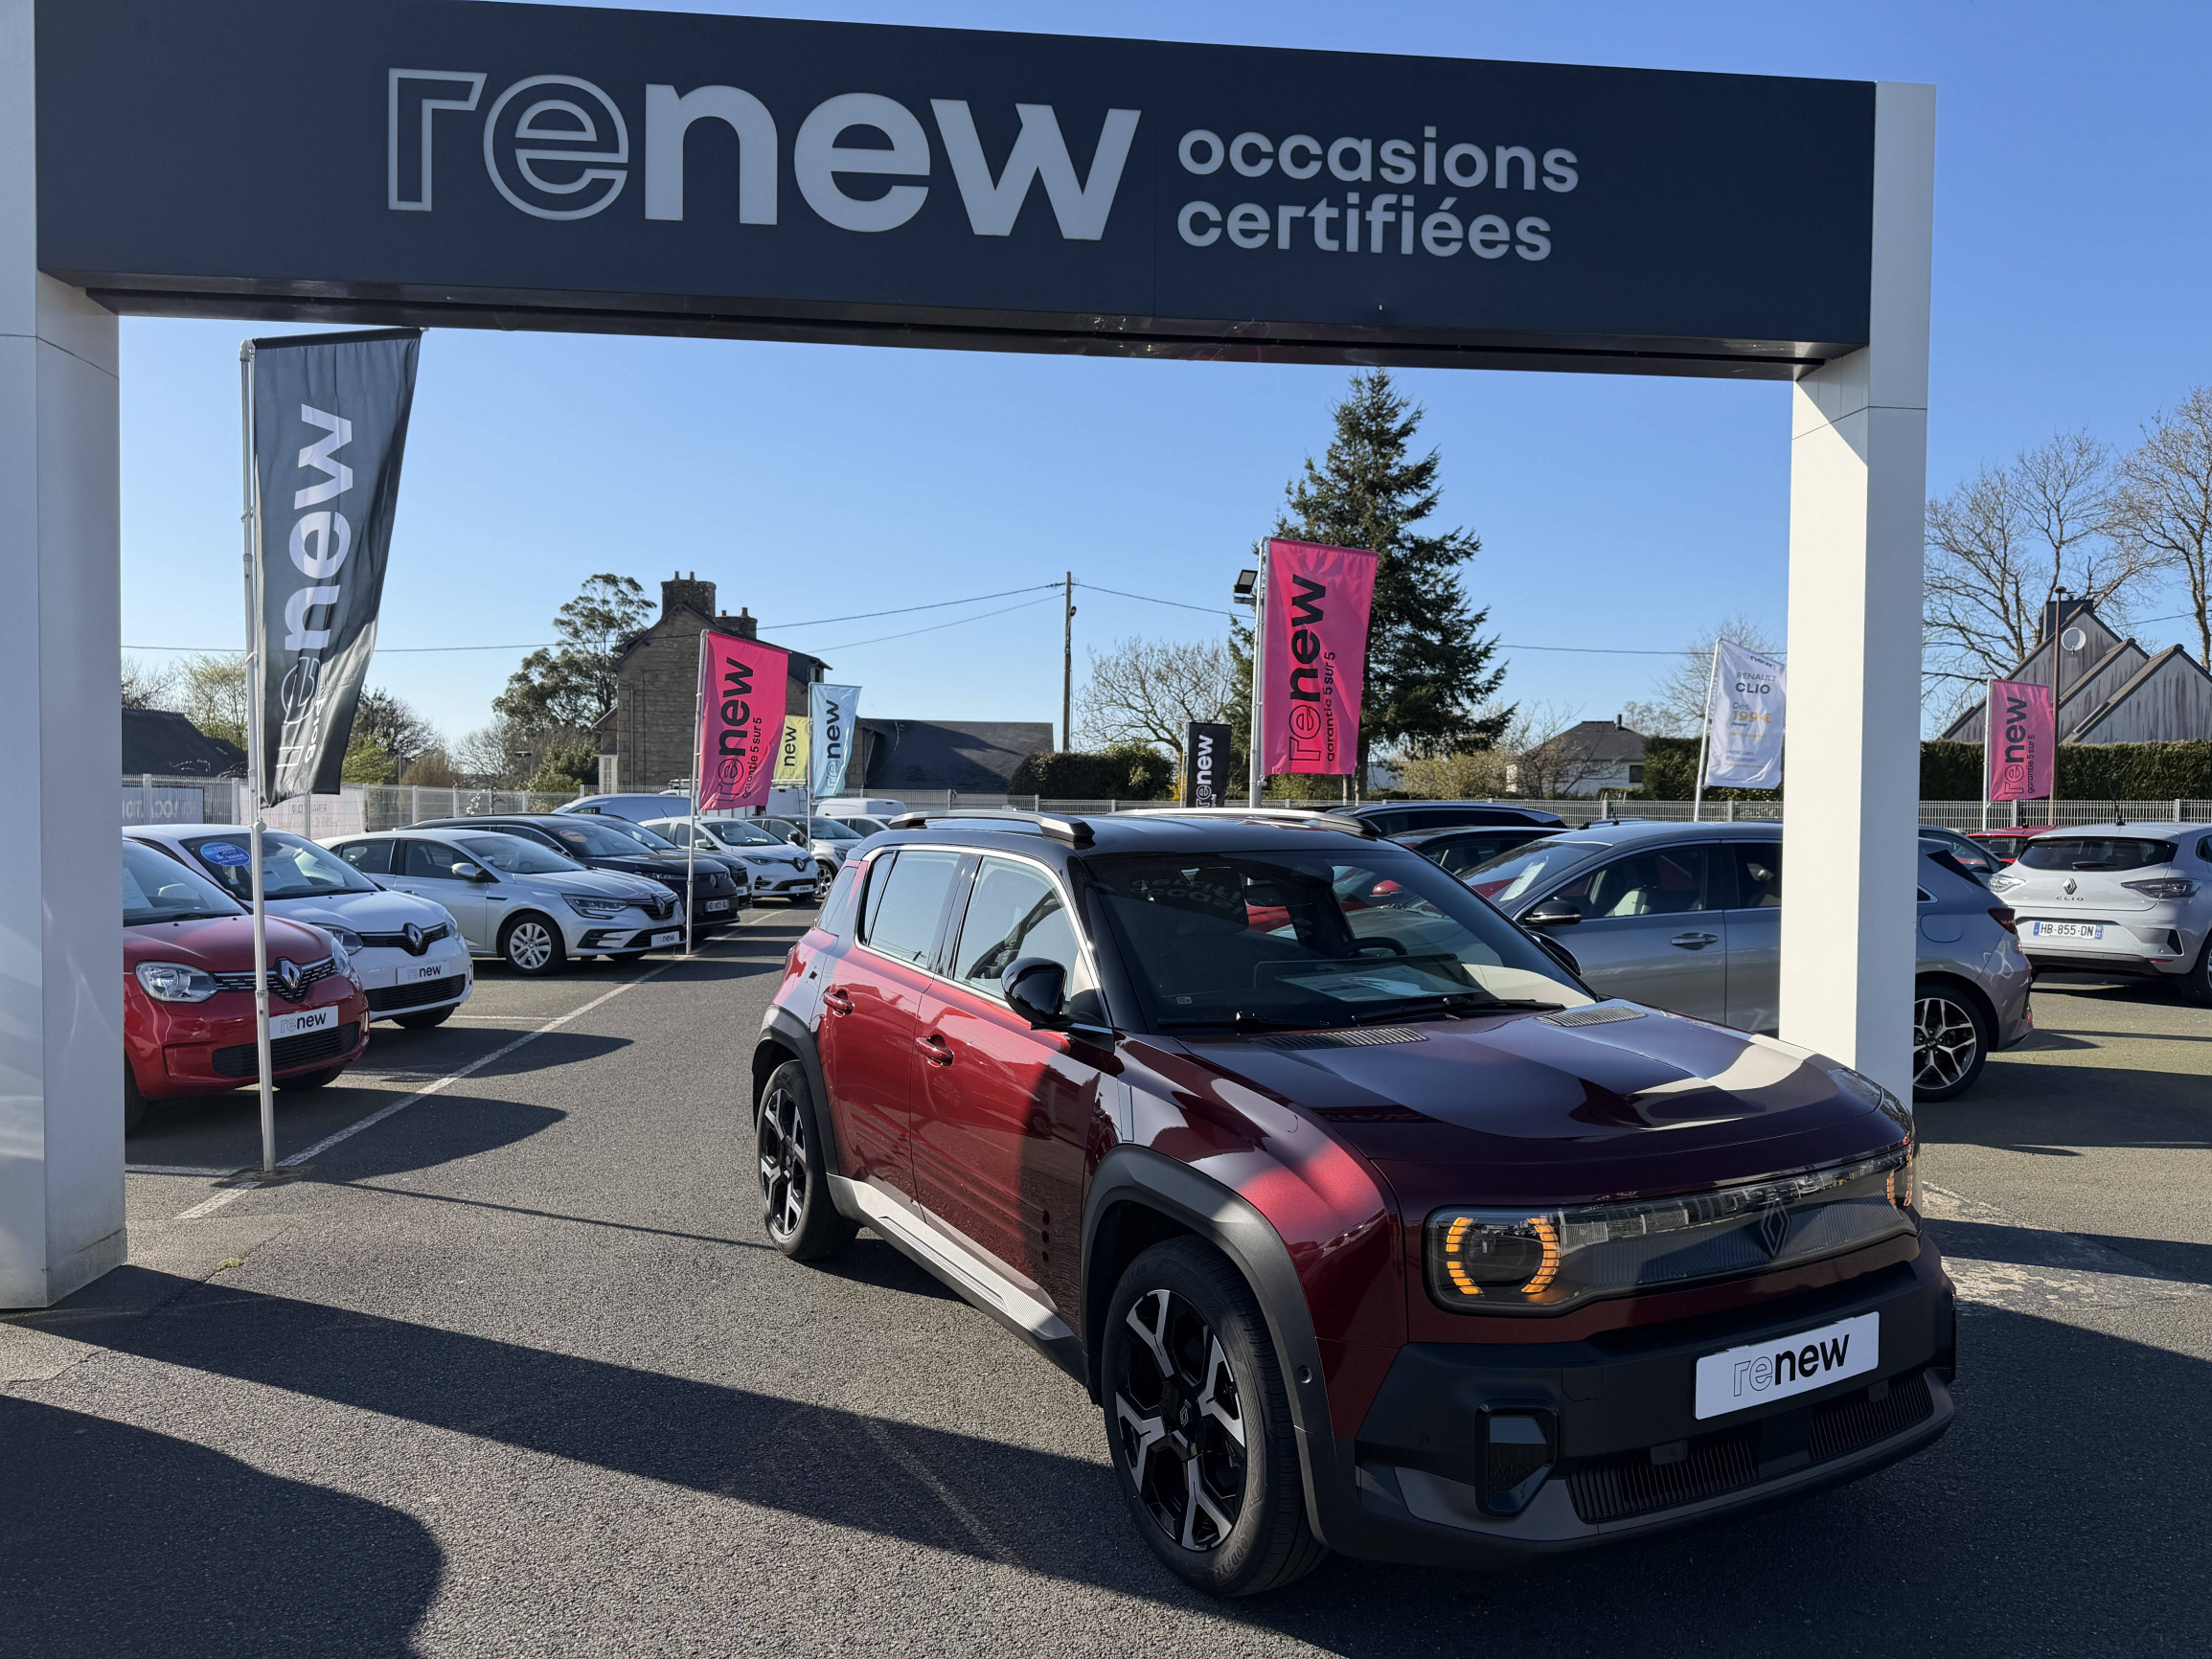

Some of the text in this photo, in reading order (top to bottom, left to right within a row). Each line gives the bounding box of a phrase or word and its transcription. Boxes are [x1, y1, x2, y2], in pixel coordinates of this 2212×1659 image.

[387, 68, 1141, 240] renew
[1178, 125, 1579, 193] occasions
[1177, 192, 1552, 261] certifiées
[279, 403, 353, 769] renew
[1289, 574, 1326, 761] renew
[1325, 651, 1335, 661] 5
[1325, 662, 1335, 685] sur
[1736, 671, 1777, 682] RENAULT
[1735, 682, 1771, 694] CLIO
[718, 656, 754, 802] renew
[753, 725, 762, 744] sur
[1732, 710, 1759, 723] 199
[2004, 696, 2027, 794] renew
[1196, 734, 1213, 808] renew
[2041, 922, 2094, 937] HB-855-DN
[405, 965, 442, 981] renew
[280, 1011, 327, 1034] renew
[1733, 1333, 1850, 1398] renew
